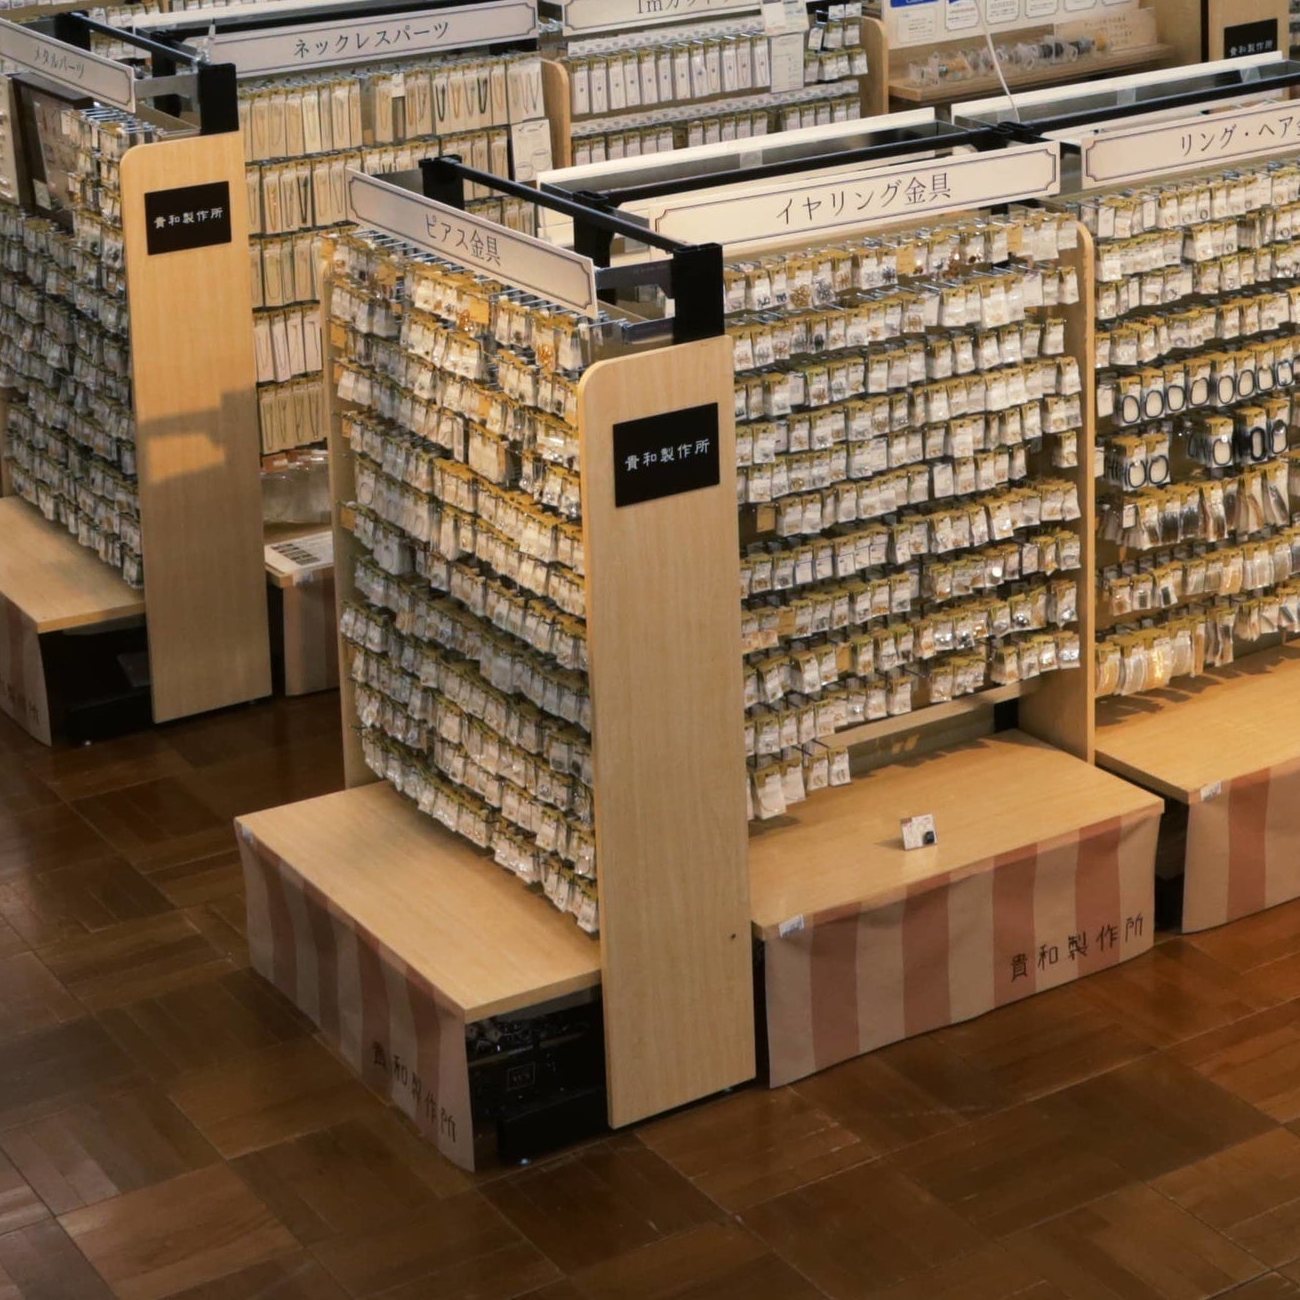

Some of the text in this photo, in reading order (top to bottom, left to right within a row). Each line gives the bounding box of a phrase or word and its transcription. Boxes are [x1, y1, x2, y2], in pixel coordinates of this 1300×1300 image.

[33, 44, 86, 80] メタルパーツ
[294, 19, 452, 61] ネックレスパーツ
[153, 205, 225, 231] 貴和製作所
[775, 171, 953, 228] イヤリング金具
[424, 210, 501, 267] ピアス金具
[624, 438, 712, 473] 貴和製作所
[1008, 913, 1146, 984] 貴和製作所
[371, 1040, 458, 1146] 貴和製作所
